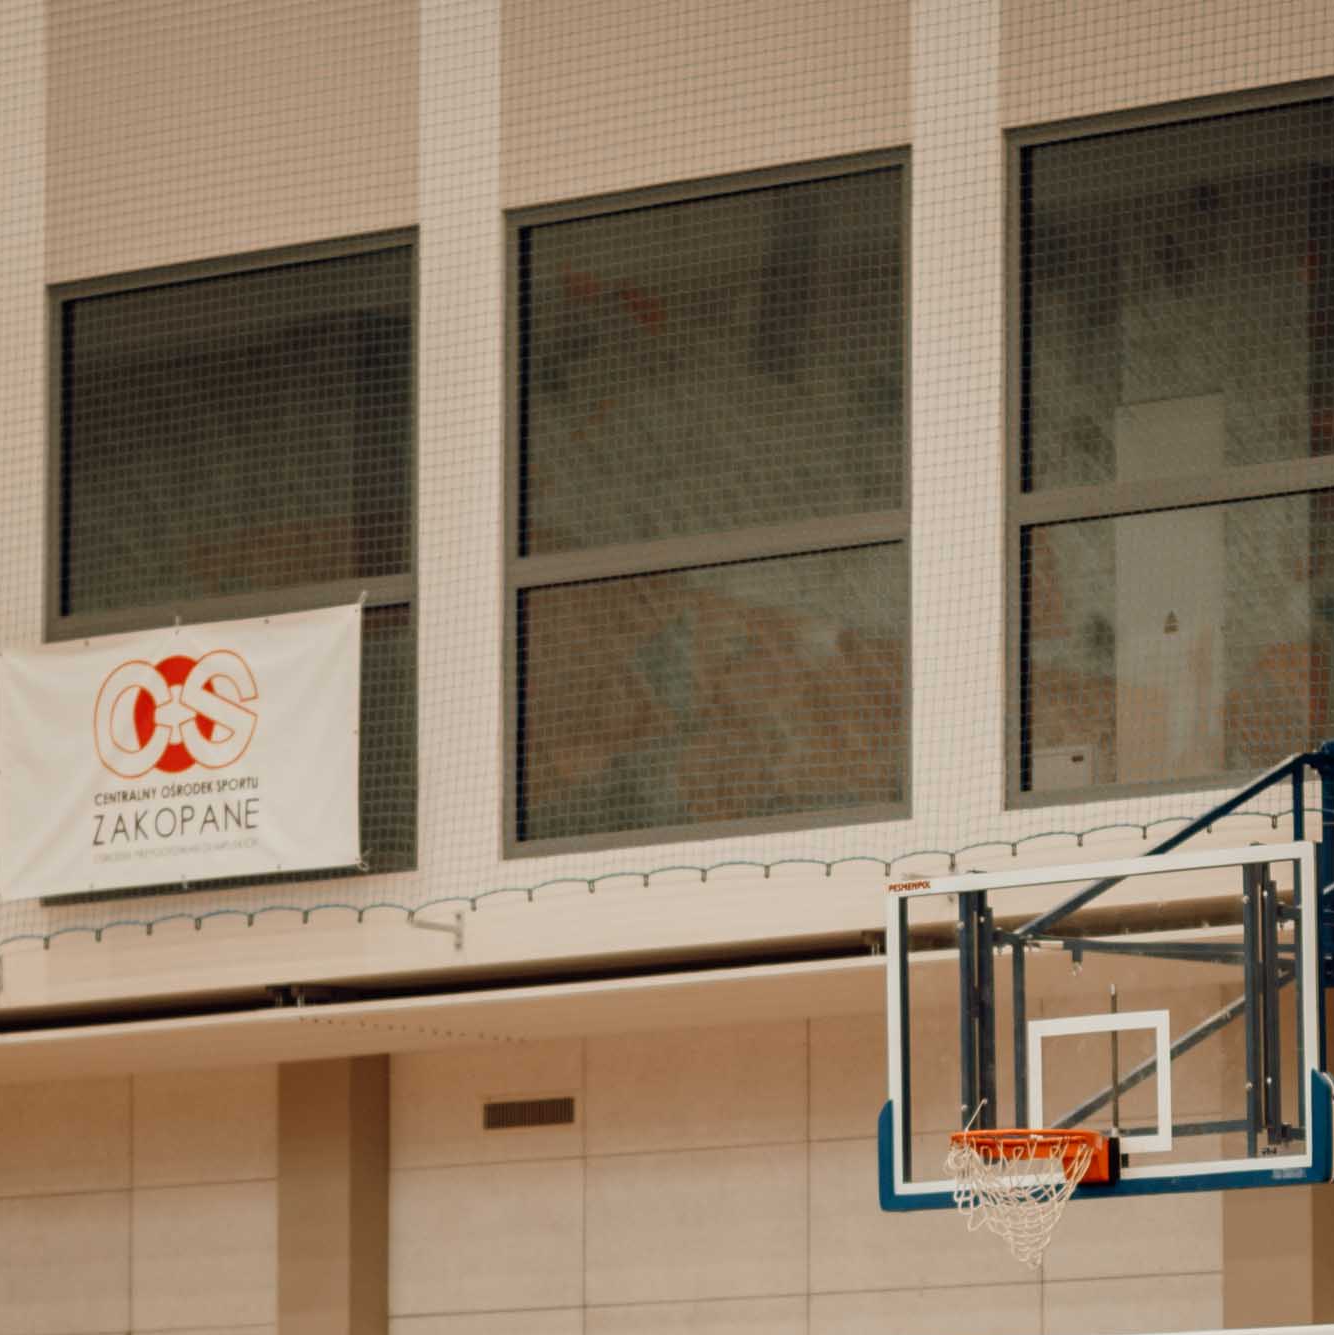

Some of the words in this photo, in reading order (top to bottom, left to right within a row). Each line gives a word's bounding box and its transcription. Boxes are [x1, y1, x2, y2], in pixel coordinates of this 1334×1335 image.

[94, 786, 157, 807] CENTRALNY
[161, 780, 213, 799] OŚRODEK
[216, 776, 259, 793] SPORTU
[93, 798, 259, 846] ZAKOPANE
